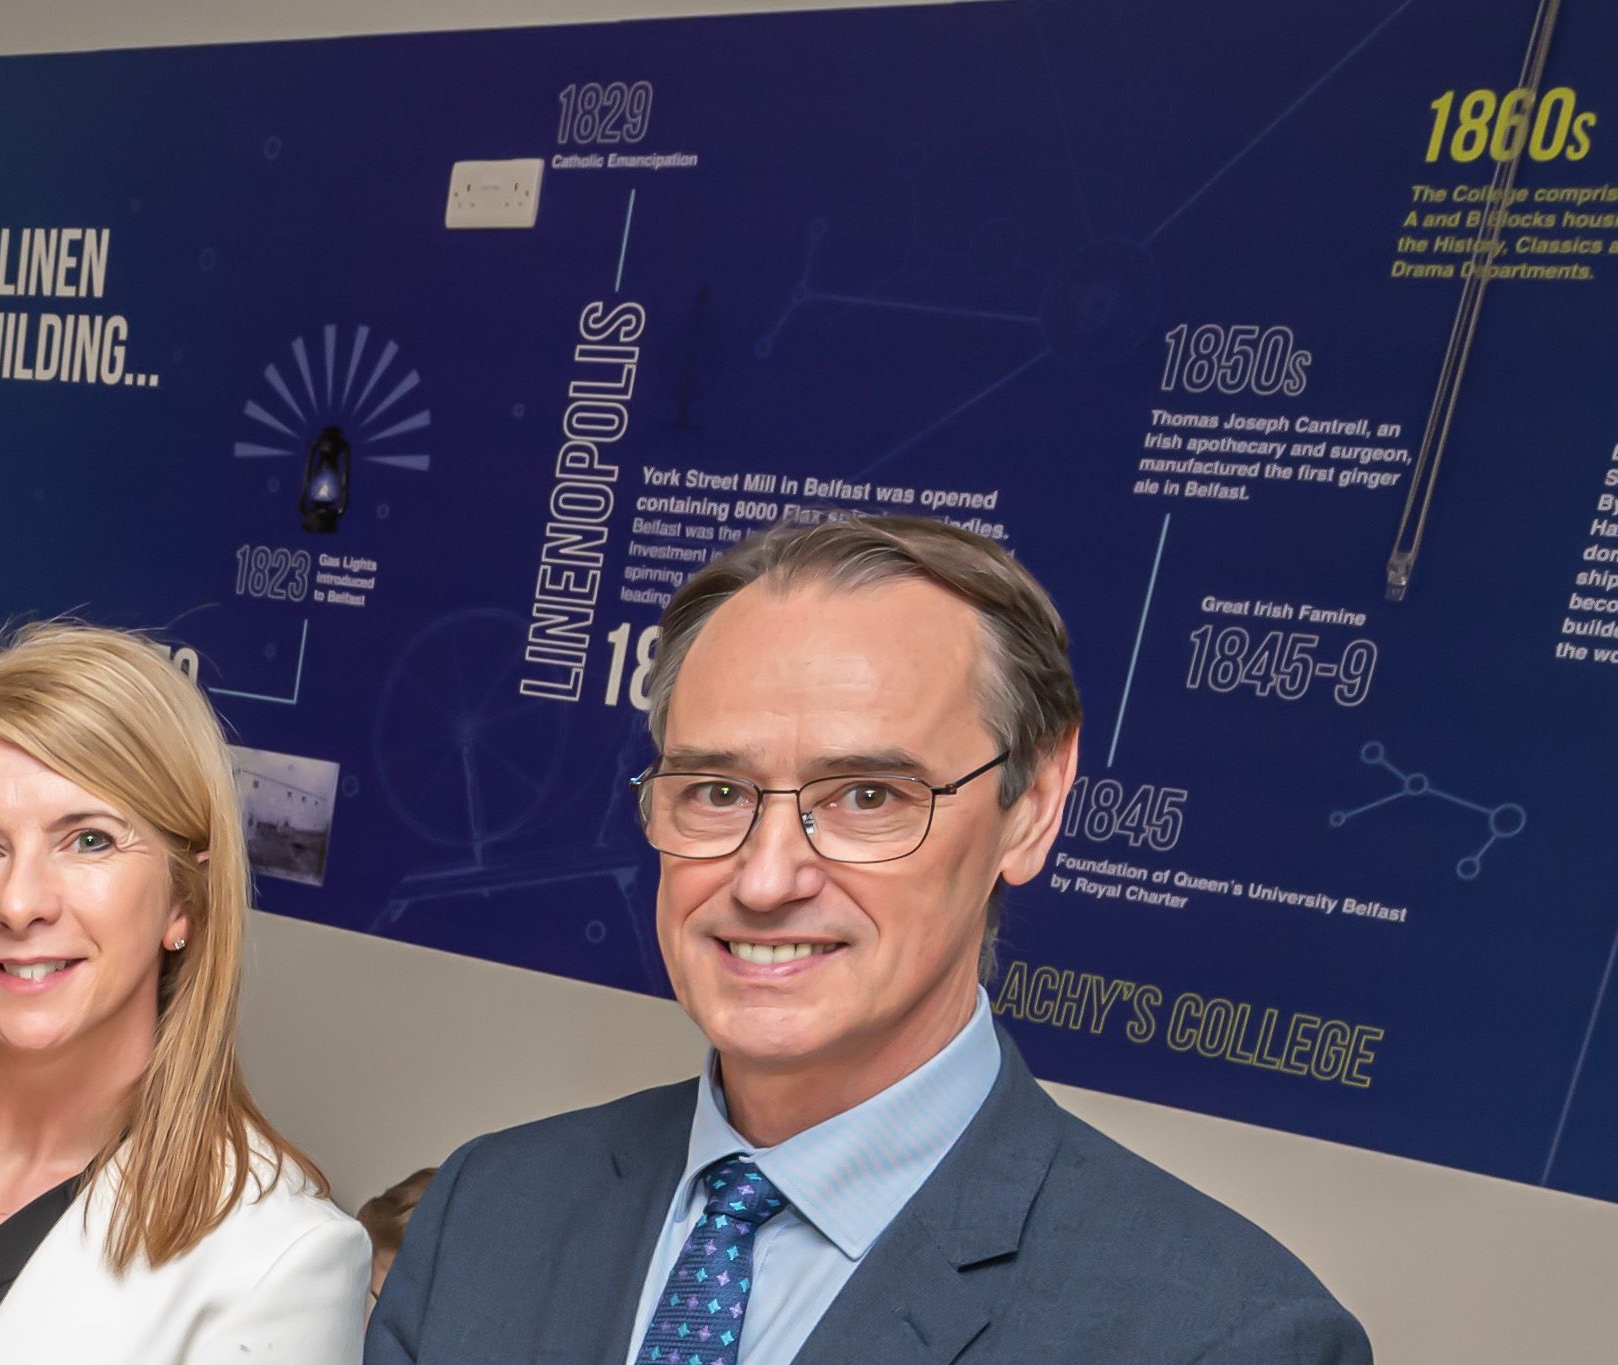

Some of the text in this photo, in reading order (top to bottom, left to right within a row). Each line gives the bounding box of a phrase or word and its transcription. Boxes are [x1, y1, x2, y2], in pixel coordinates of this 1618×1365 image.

[557, 80, 653, 144] 1829
[1425, 87, 1597, 163] 1860s
[552, 152, 698, 170] Catholic Emancipation
[1413, 186, 1447, 202] The
[1403, 211, 1418, 228] A
[1423, 211, 1461, 228] and
[1398, 236, 1428, 253] the
[1516, 236, 1603, 254] Classics
[1391, 260, 1455, 278] Drama
[1162, 324, 1311, 396] 1850s
[1151, 409, 1401, 438] Thomas Joseph Cantrell, an
[1145, 432, 1412, 466] Irish apothecary and surgeon,
[1139, 457, 1402, 490] manufactured the first ginger
[520, 301, 646, 702] LINENOPOLIS
[643, 466, 998, 511] York Street Mill in Belfast was opened
[1134, 479, 1250, 500] ale in Belfast.
[636, 496, 730, 522] containing
[734, 501, 778, 521] 8000
[633, 517, 682, 537] Belfast
[685, 525, 714, 540] was
[718, 525, 742, 541] the
[236, 544, 311, 602] 1823
[319, 553, 378, 573] Gas Lights
[624, 564, 683, 587] spinning
[316, 571, 375, 590] introduced
[314, 589, 365, 607] to Belfast
[621, 585, 672, 609] leading
[1201, 595, 1367, 626] Great Irish Famine
[1186, 624, 1378, 707] 1845-9
[1555, 642, 1588, 660] the
[1064, 776, 1188, 851] 1845
[1051, 873, 1189, 909] by Royal Charter
[1056, 852, 1408, 923] Foundation of Queen's University Belfast
[993, 961, 1385, 1088] ACHY'S COLLEGE
